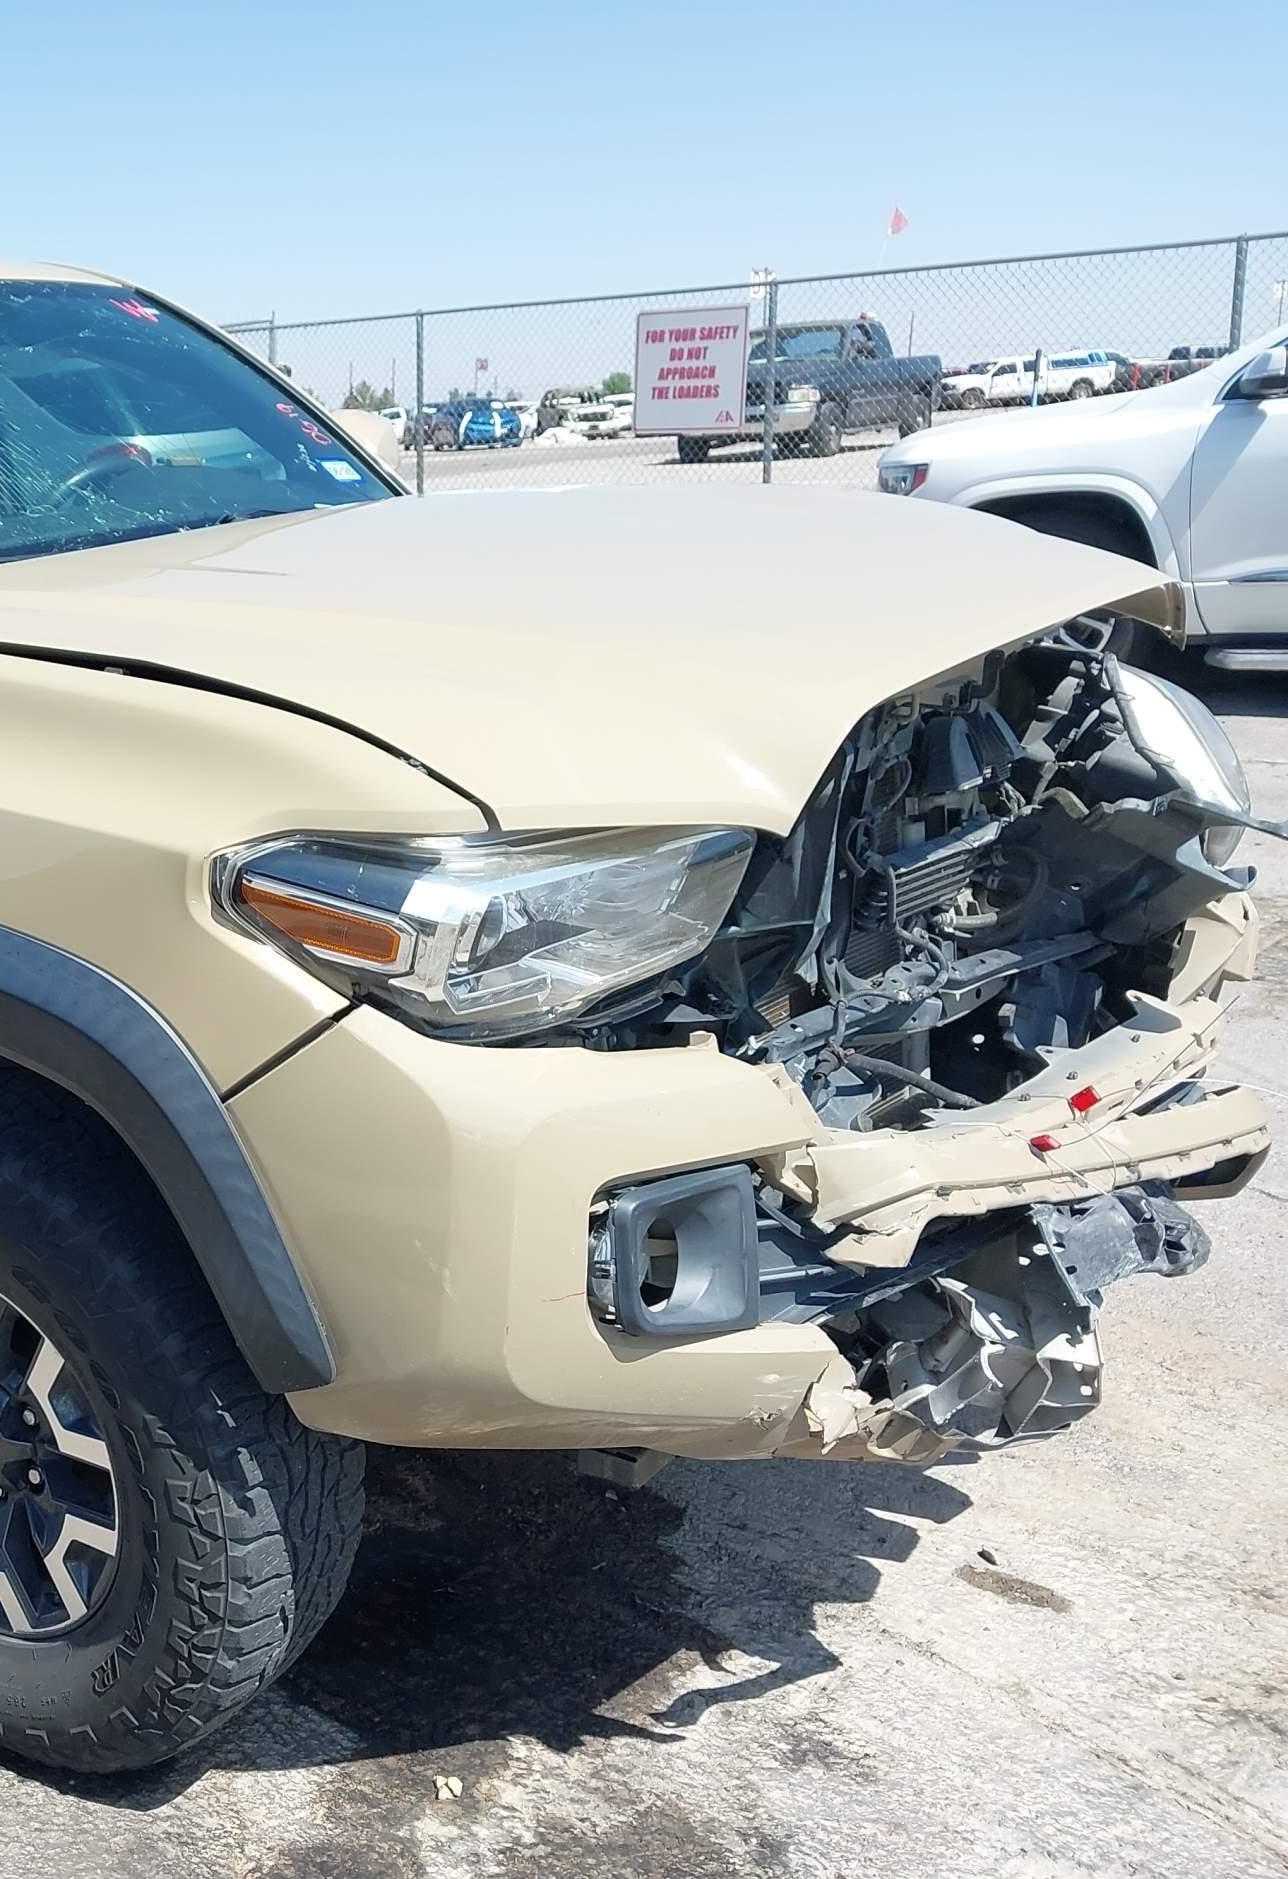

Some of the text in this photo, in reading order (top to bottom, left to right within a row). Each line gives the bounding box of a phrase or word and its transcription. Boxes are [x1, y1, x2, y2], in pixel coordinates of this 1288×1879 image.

[645, 325, 740, 344] FOR YOUR SAFETY
[669, 346, 709, 361] DO NOT
[657, 365, 716, 381] APPROACH
[651, 384, 720, 400] THE LOADERS
